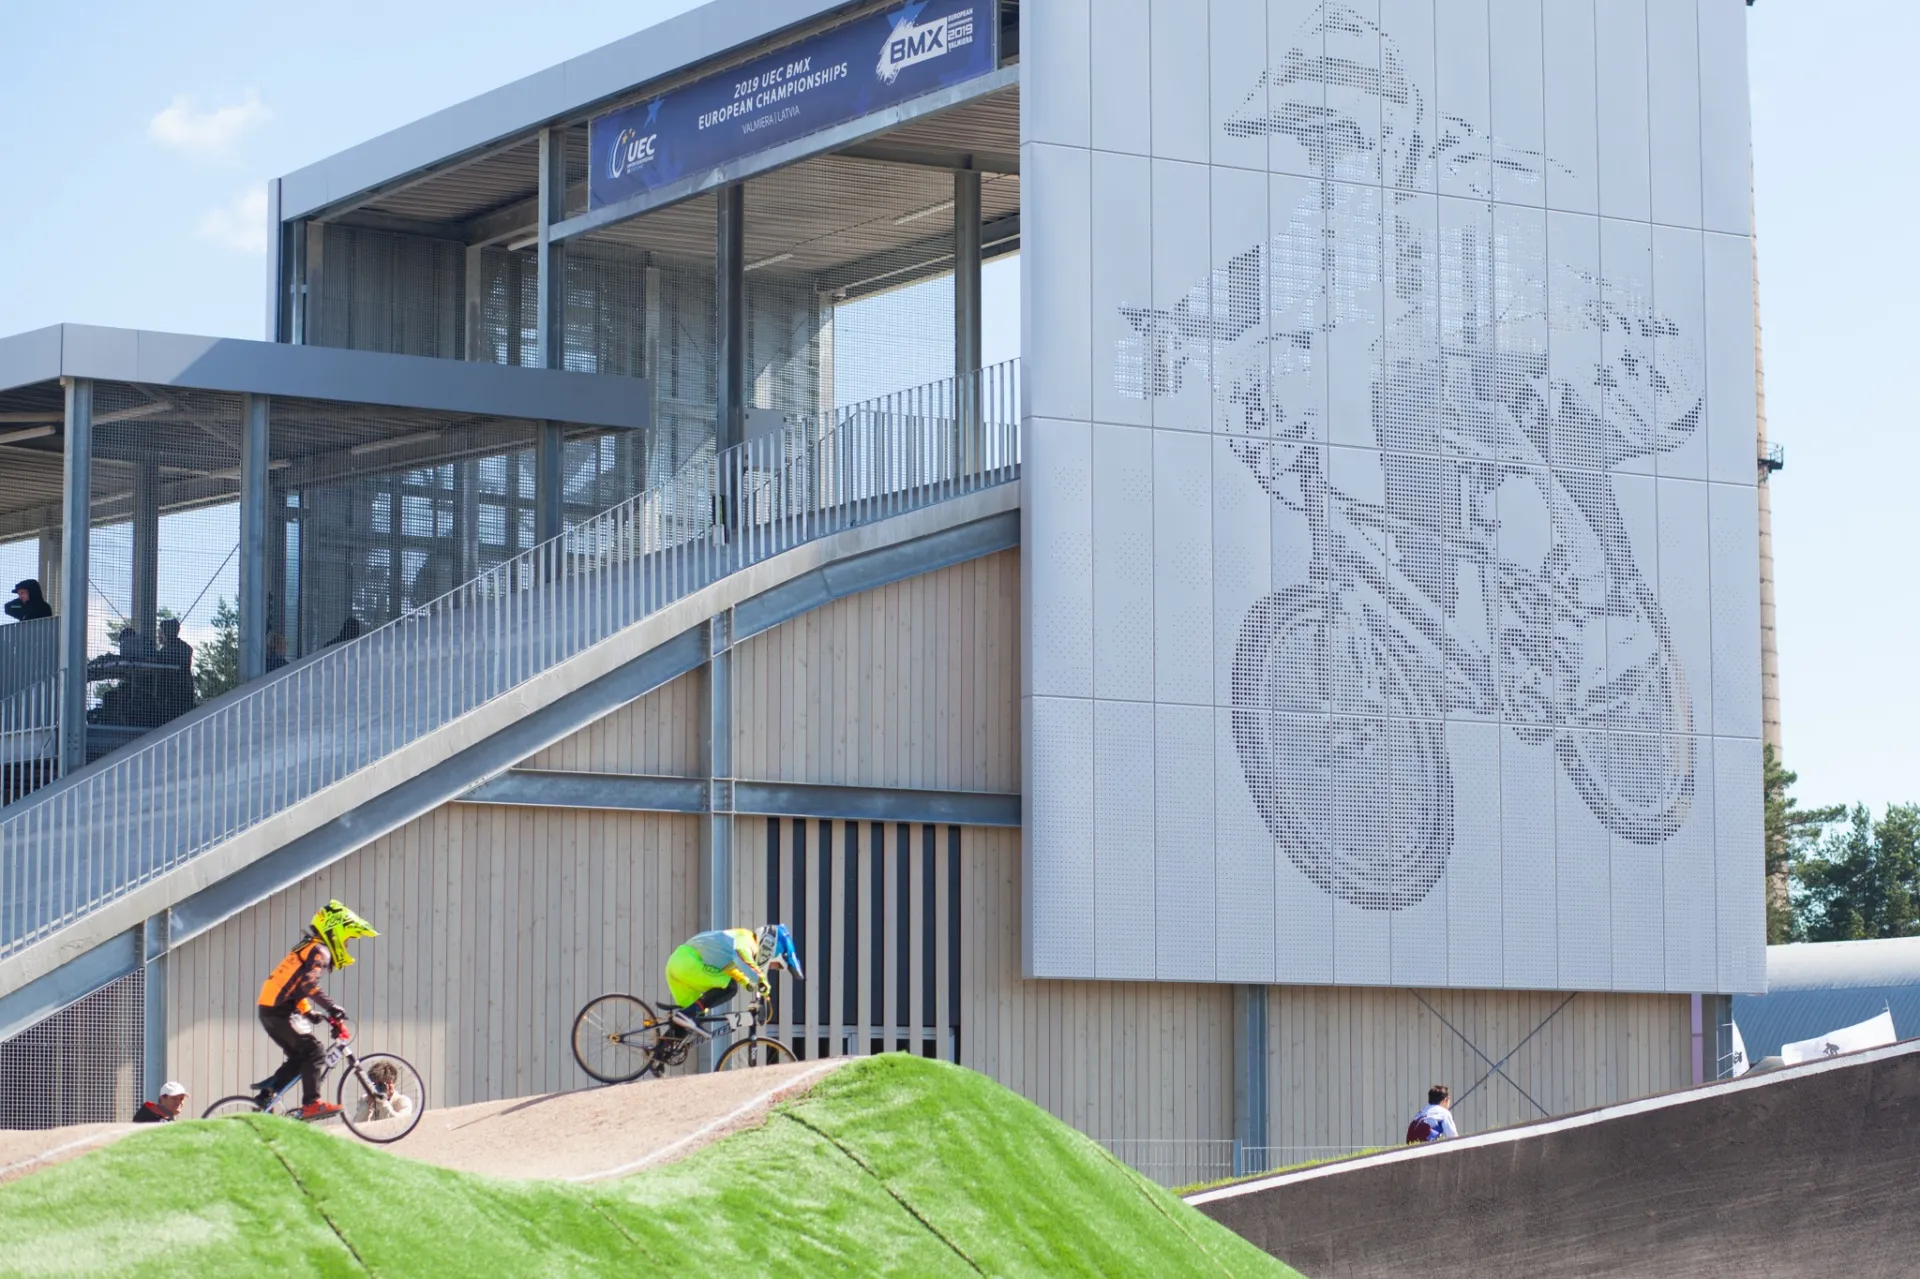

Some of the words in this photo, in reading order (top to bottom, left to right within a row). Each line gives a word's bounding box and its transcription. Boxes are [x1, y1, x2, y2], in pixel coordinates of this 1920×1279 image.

[890, 24, 944, 65] BMX
[948, 23, 973, 41] 2019
[733, 76, 760, 99] 2019
[761, 67, 784, 88] UEC
[786, 56, 812, 79] BMX
[698, 97, 753, 131] EUROPEAN
[755, 62, 848, 109] CHAMPIONSHIPS
[741, 115, 774, 135] VALMIERA
[777, 105, 801, 122] LATVIA
[627, 133, 657, 163] UEC
[734, 1012, 742, 1028] 2
